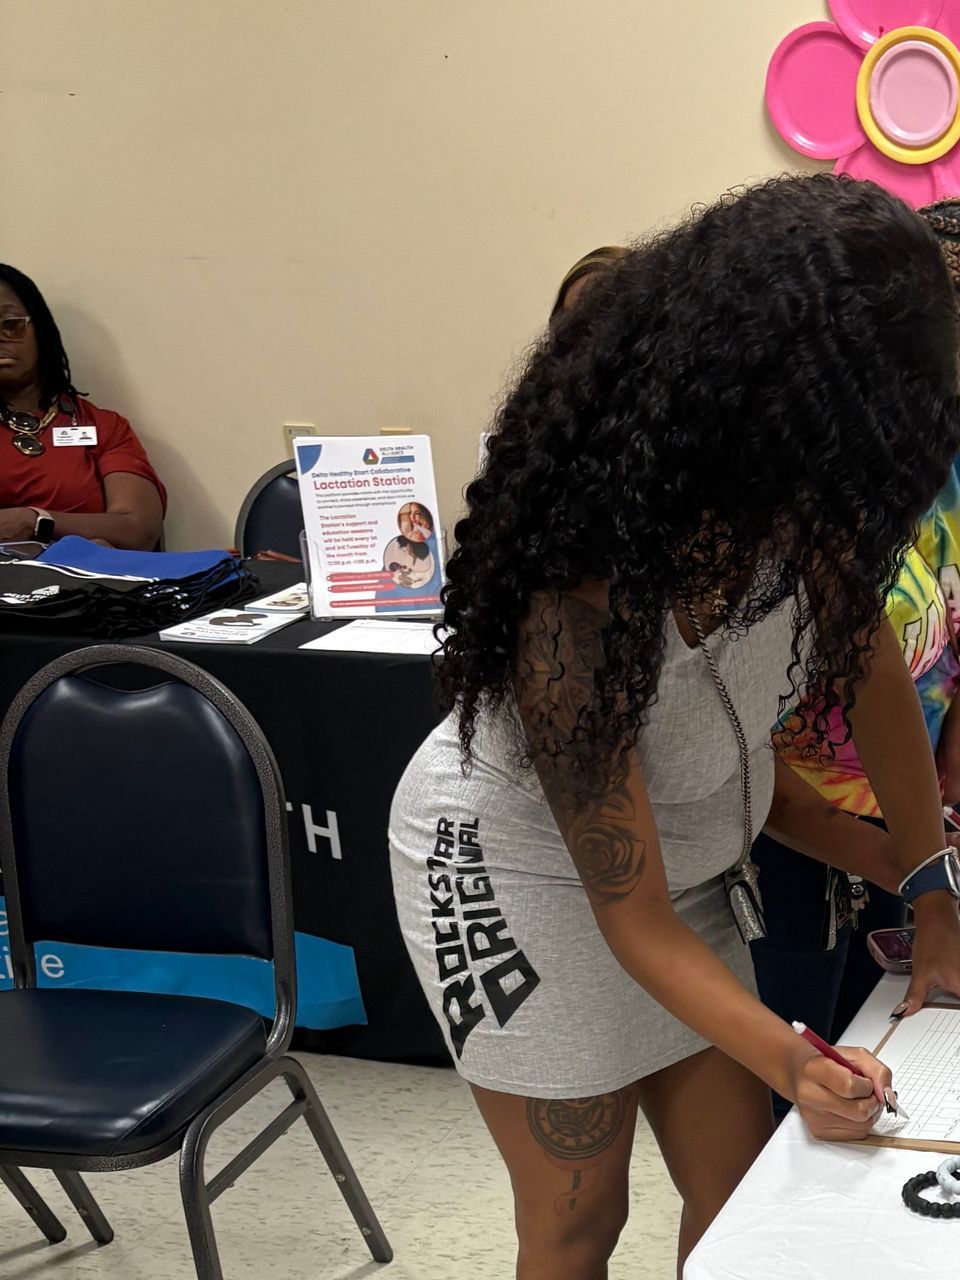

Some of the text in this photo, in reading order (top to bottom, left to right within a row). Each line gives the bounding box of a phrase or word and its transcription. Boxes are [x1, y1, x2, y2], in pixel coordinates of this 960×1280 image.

[313, 475, 415, 490] Lactation Station
[427, 816, 486, 1061] ROCKSTAR
[454, 817, 542, 1029] ORIGINAL
